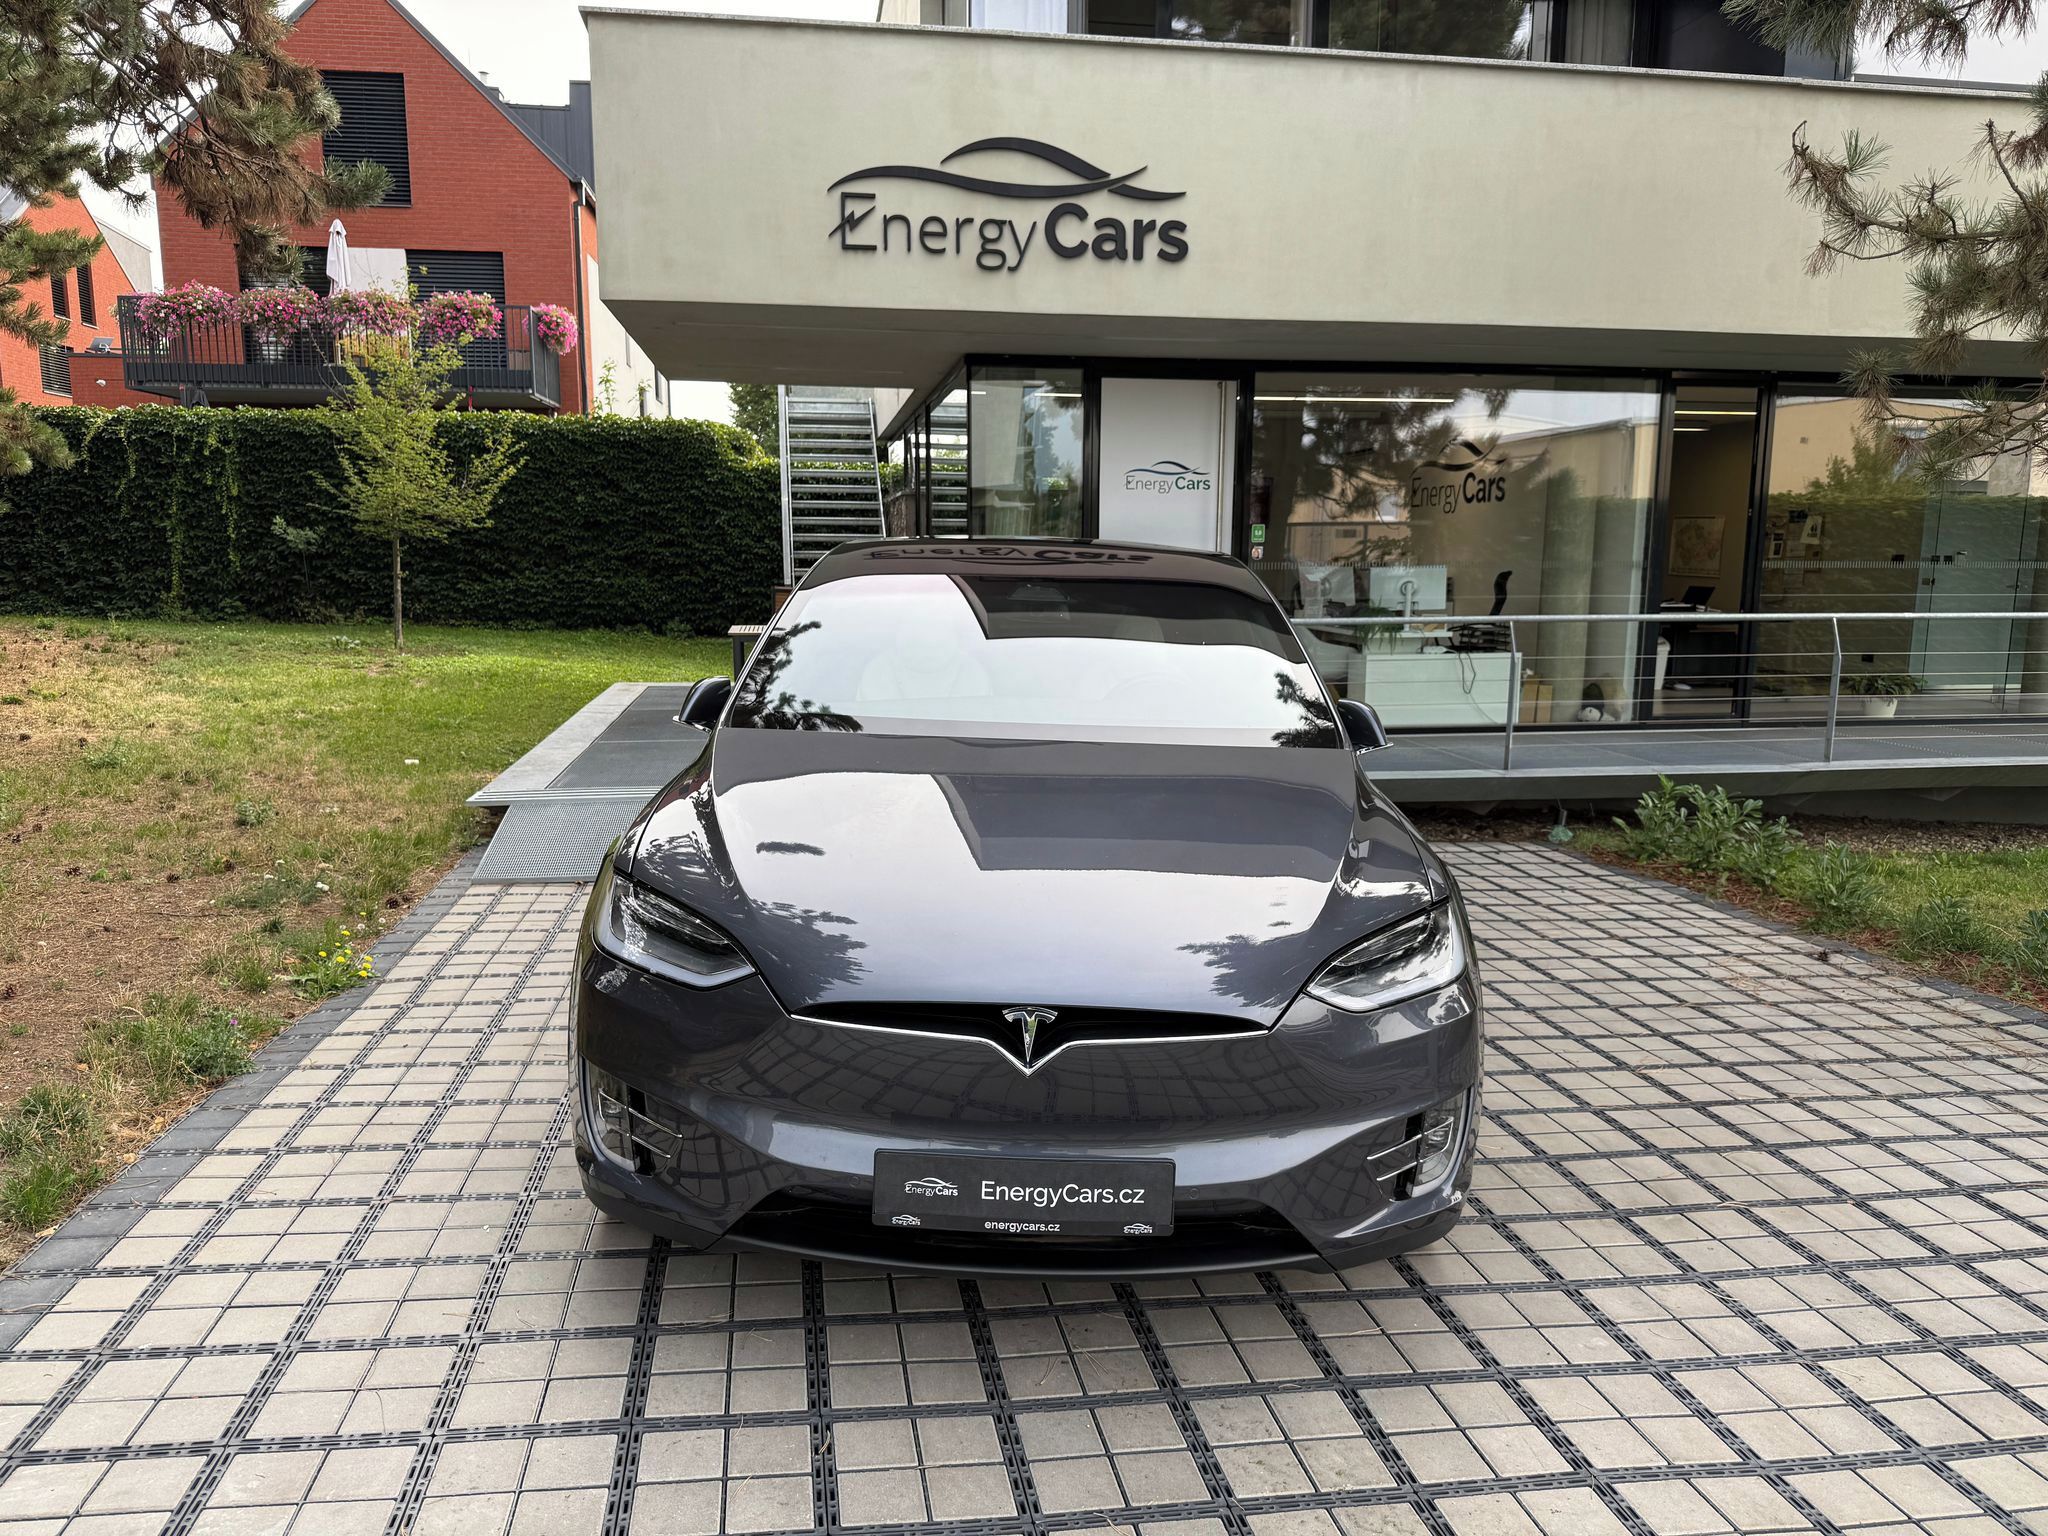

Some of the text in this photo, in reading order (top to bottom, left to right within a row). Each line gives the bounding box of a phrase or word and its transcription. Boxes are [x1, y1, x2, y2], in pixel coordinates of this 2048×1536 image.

[828, 192, 1189, 272] EnergyCars
[1124, 475, 1211, 494] EnergyCars
[1410, 472, 1506, 514] EnergyCars
[904, 1184, 958, 1196] EnergyCars
[981, 1180, 1145, 1207] EnergyCars.cz
[984, 1221, 1061, 1233] energycars.cz
